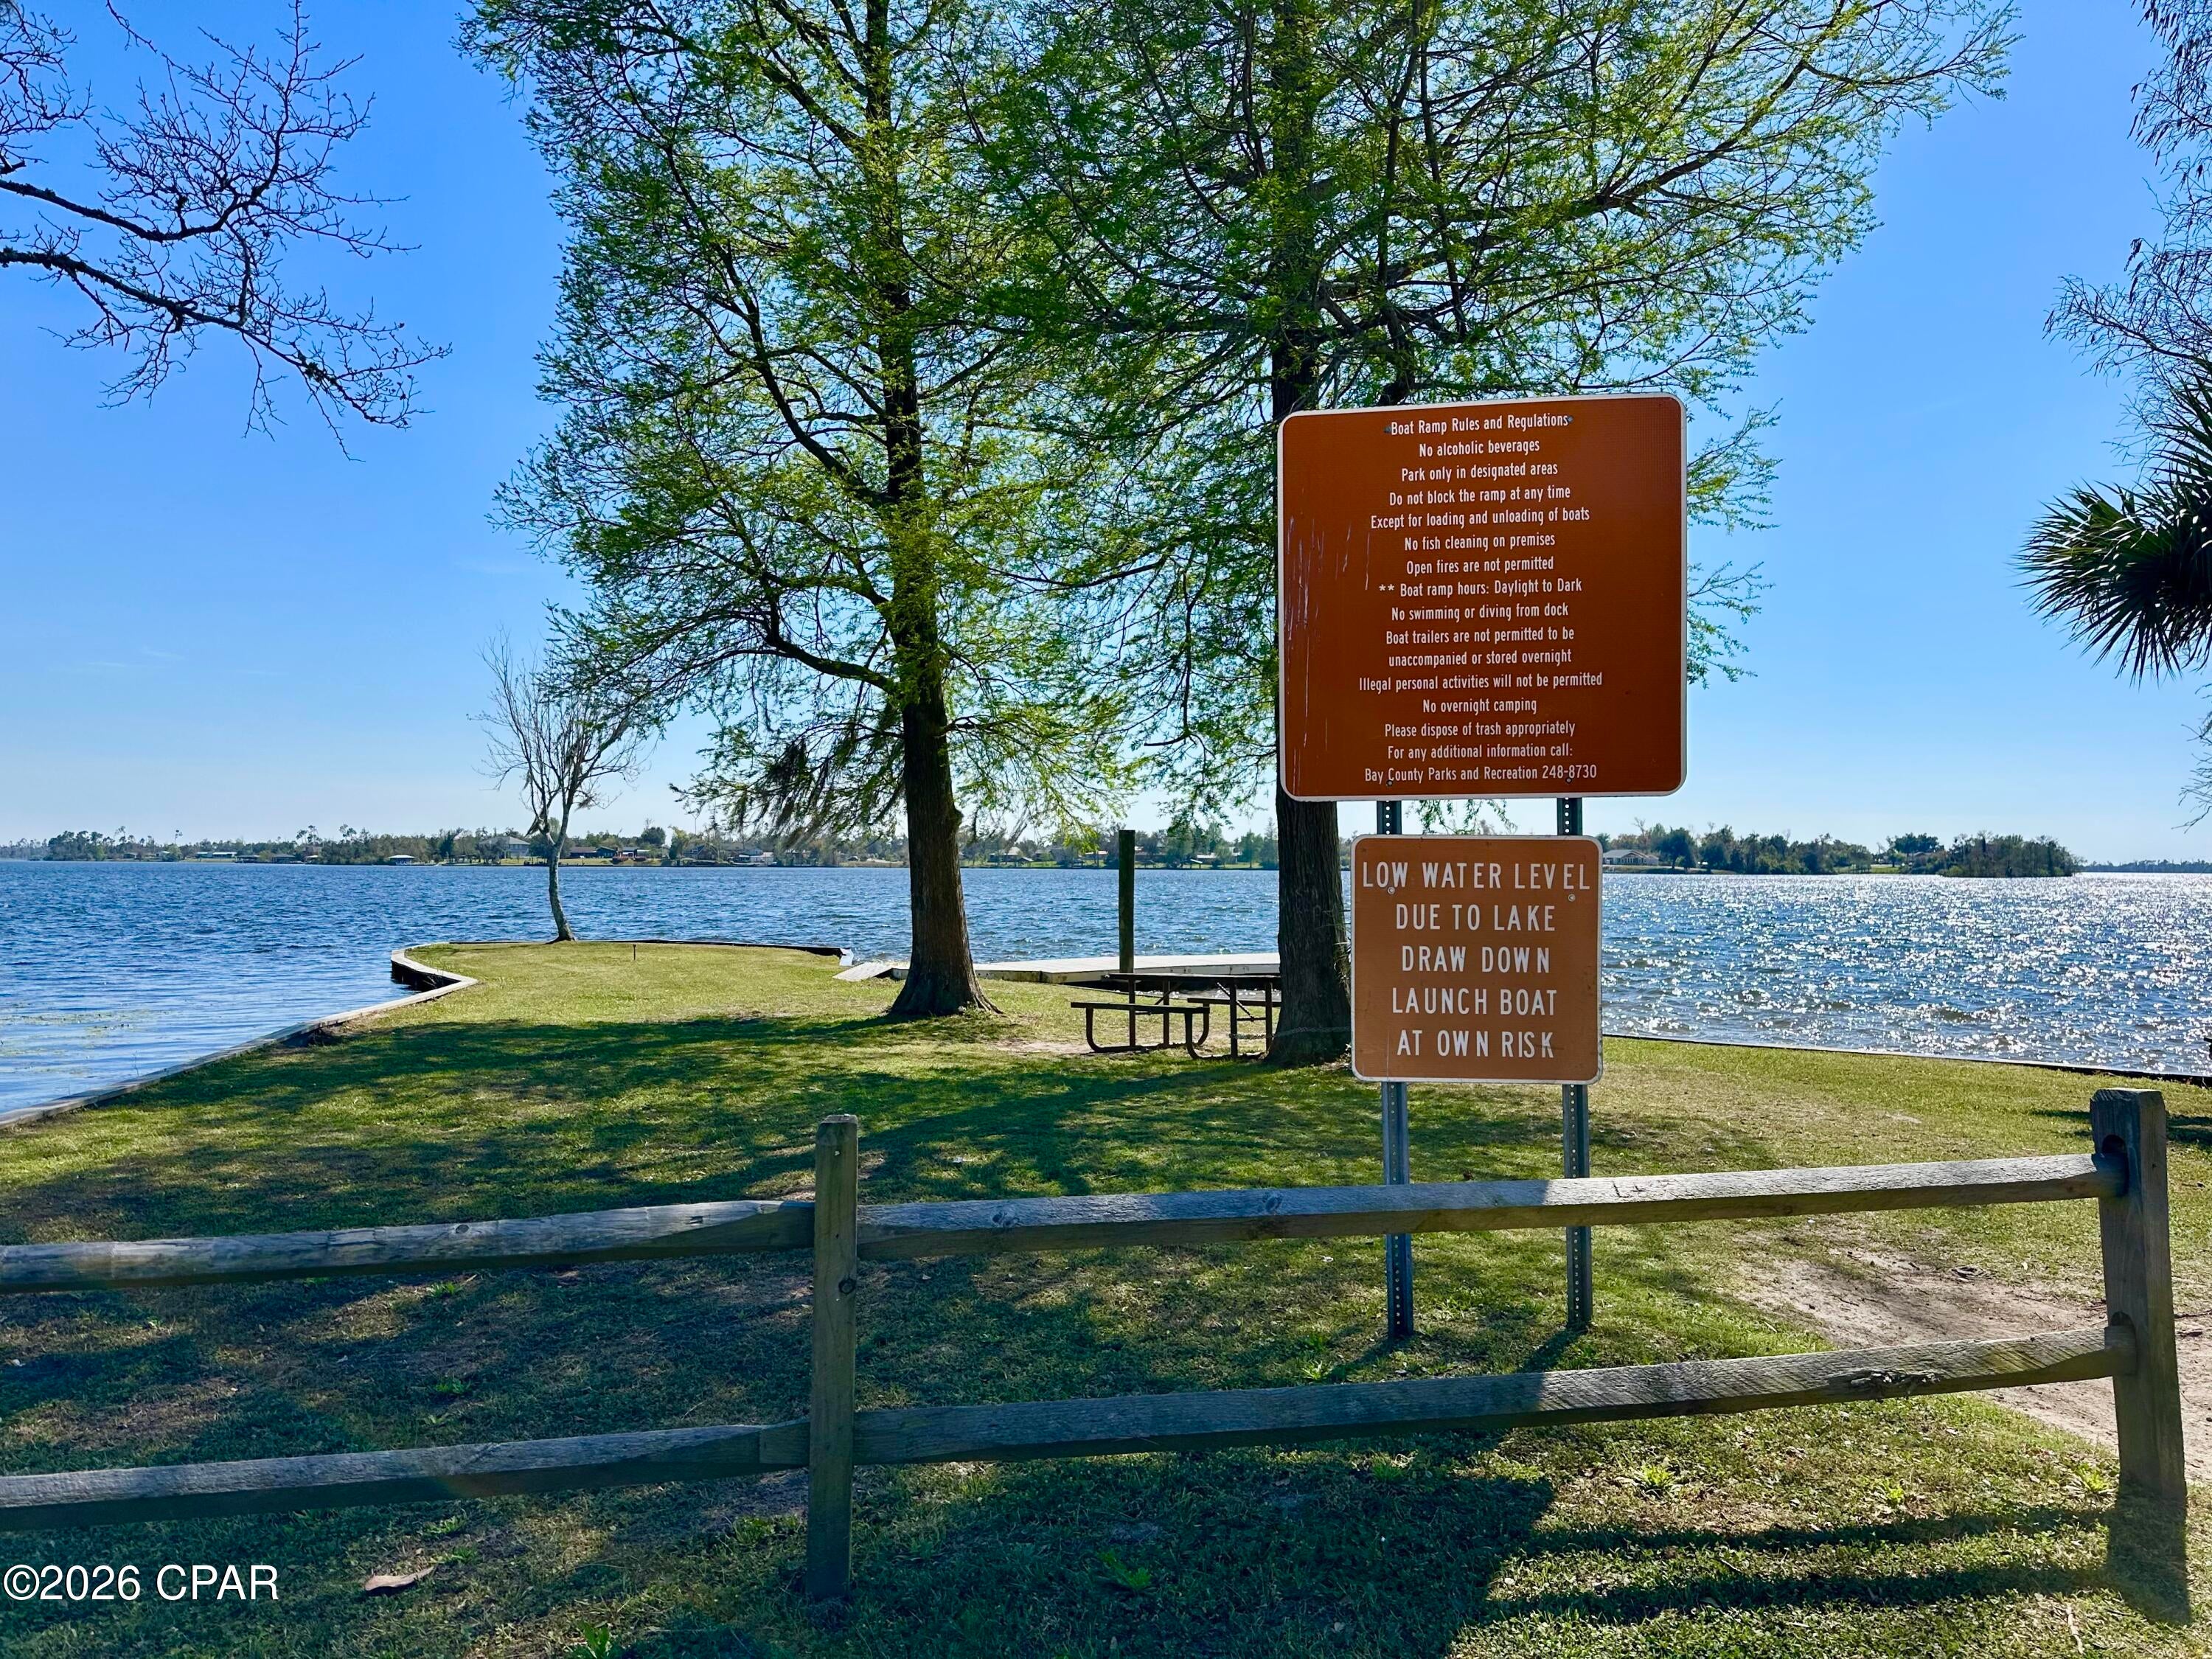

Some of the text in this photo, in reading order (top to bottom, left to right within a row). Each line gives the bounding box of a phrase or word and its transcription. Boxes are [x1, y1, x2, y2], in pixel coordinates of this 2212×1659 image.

[1391, 413, 1569, 436] Boat Ramp Rules and Regulations
[1419, 439, 1540, 457] No alcoholic beverages
[1402, 462, 1558, 483] Park only in designated areas
[1389, 484, 1571, 506] Do not block the ramp at any time
[1371, 507, 1590, 531] Except for loading and unloading of boats
[1405, 532, 1555, 552] No fish cleaning on premises
[1406, 556, 1554, 577] Open fires are not permitted
[1400, 582, 1423, 597] Boat
[1427, 585, 1453, 598] ramp
[1458, 582, 1489, 595] hours:
[1495, 579, 1539, 597] Daylight
[1542, 578, 1552, 592] to
[1557, 577, 1582, 592] Dark
[1391, 602, 1568, 623] No swimming or diving from dock
[1386, 626, 1574, 644] Boat trailers are not permitted to be
[1388, 648, 1571, 669] unaccompanied or stored overnight
[1360, 672, 1602, 695] Illegal personal activities will not be permitted
[1423, 698, 1537, 716] No overnight camping
[1385, 720, 1576, 739] Please dispose of trash appropriately
[1388, 742, 1573, 762] For any additional information call:
[1364, 764, 1597, 784] Bay County Parks and Recreation 248-8730
[1363, 862, 1590, 889] LOW WATER LEVEL
[1397, 904, 1555, 931] DUE TO LAKE
[1402, 945, 1549, 973] DRAW DOWN
[1392, 987, 1557, 1015] LAUNCH BOAT
[1397, 1029, 1554, 1058] AT OWN RISK
